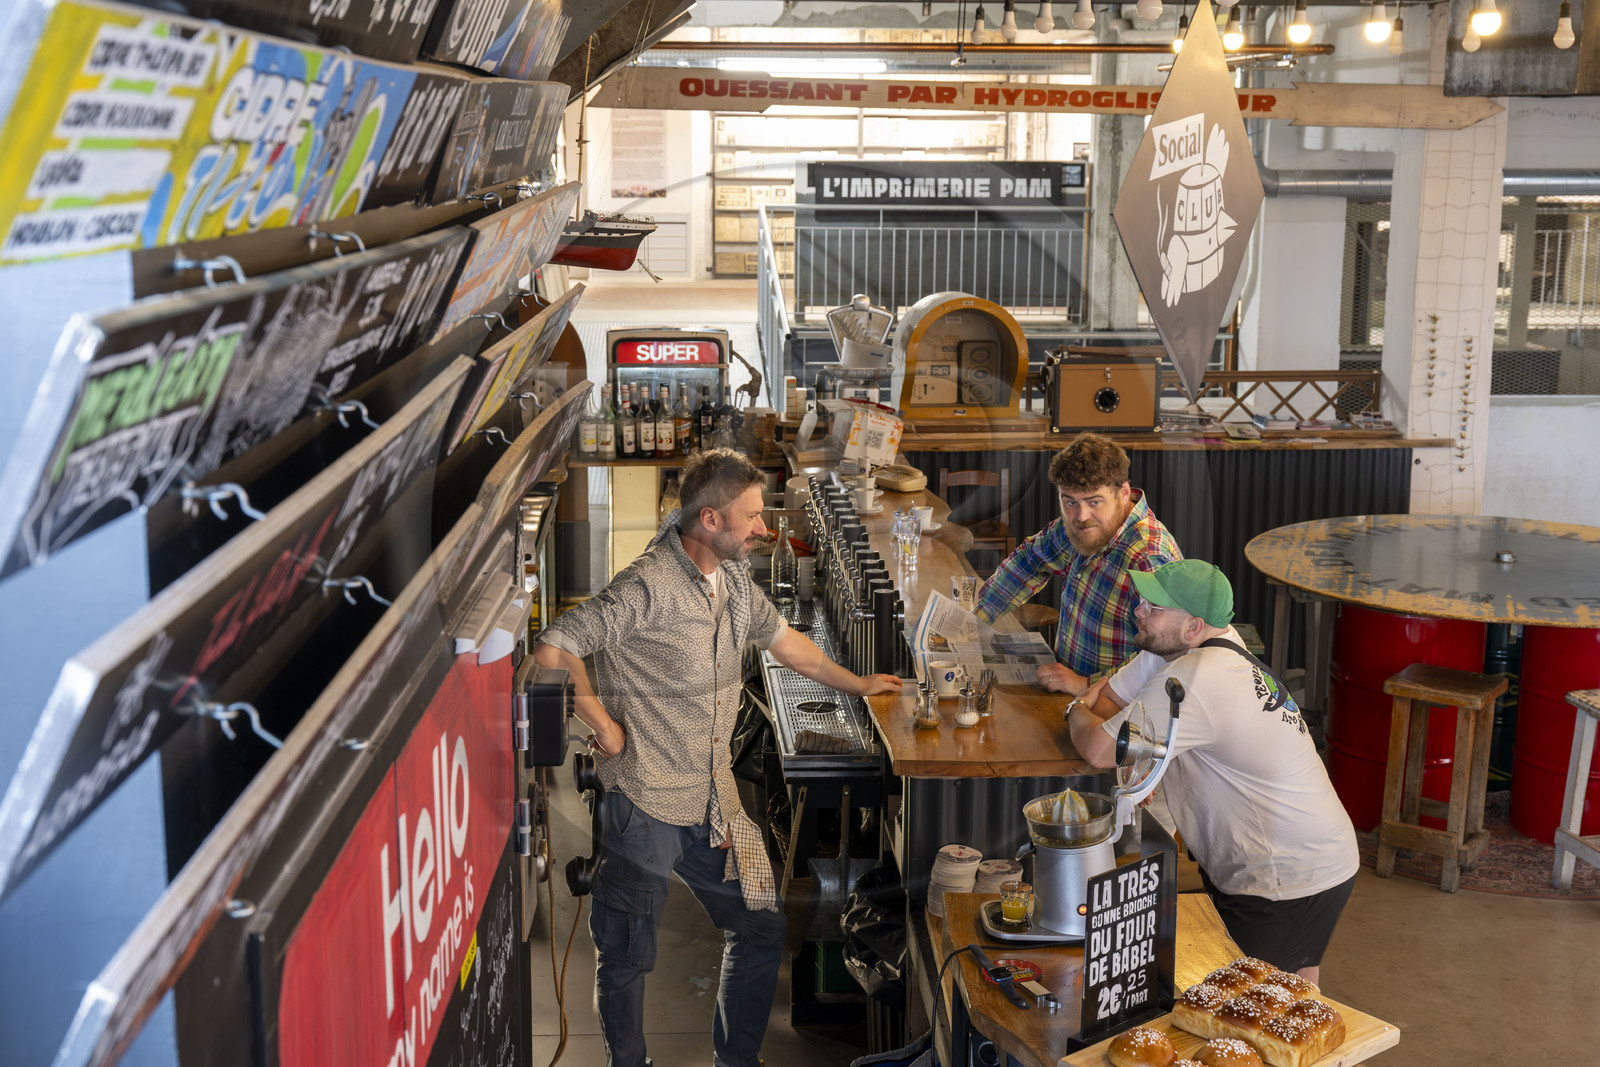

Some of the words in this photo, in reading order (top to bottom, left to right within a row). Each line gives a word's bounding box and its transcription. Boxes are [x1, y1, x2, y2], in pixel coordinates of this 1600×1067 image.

[211, 65, 327, 144] CIDRE
[679, 77, 868, 101] OUESSANT
[887, 85, 959, 105] PAR
[973, 87, 1277, 112] HYDROGLIR
[1158, 123, 1201, 168] Social
[999, 178, 1053, 198] PAM
[1177, 188, 1222, 222] CLUB
[636, 344, 700, 361] SUPER
[380, 731, 469, 1020] Hello
[1093, 879, 1112, 913] LA
[1123, 893, 1158, 918] BRIOCHE
[419, 895, 463, 1046] name
[464, 859, 475, 920] is
[1090, 927, 1112, 959] DU
[1115, 910, 1156, 950] FOUR
[1089, 956, 1109, 987] DE
[1111, 939, 1155, 979] BABEL
